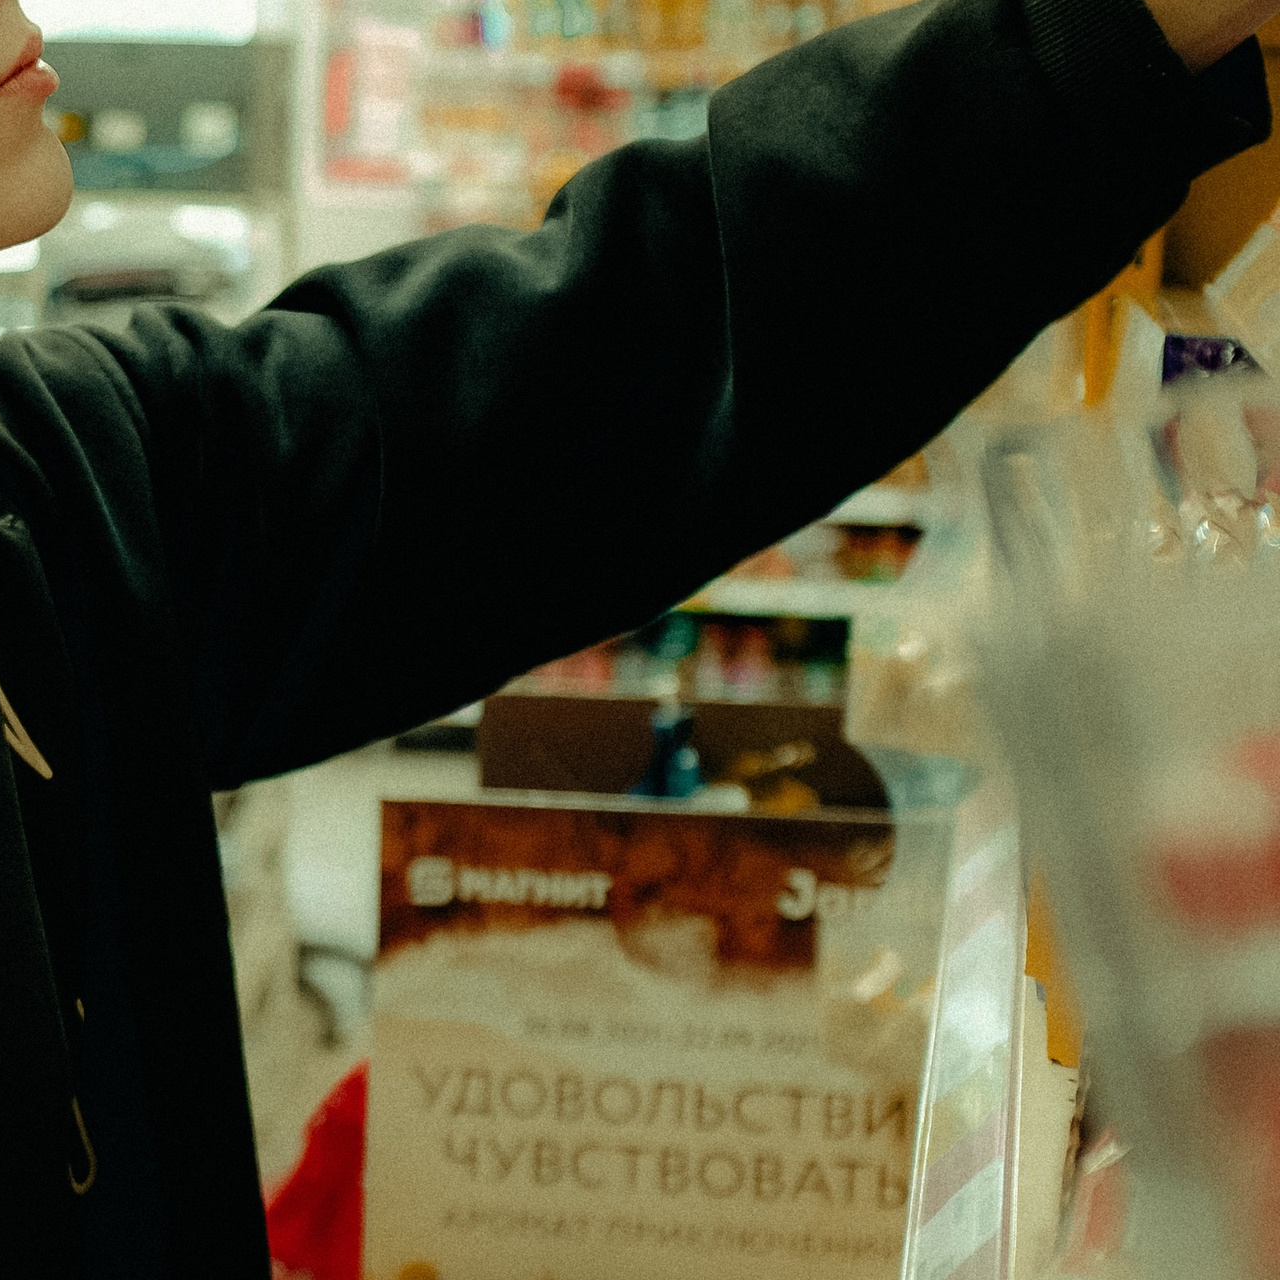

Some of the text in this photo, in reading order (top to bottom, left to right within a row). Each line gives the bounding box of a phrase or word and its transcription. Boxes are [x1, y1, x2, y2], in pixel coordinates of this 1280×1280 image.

[458, 866, 613, 910] МАГНИТ
[414, 1065, 912, 1143] УДОВОЛЬСТВИ
[442, 1134, 910, 1212] ЧУВСТВОВАТЬ
